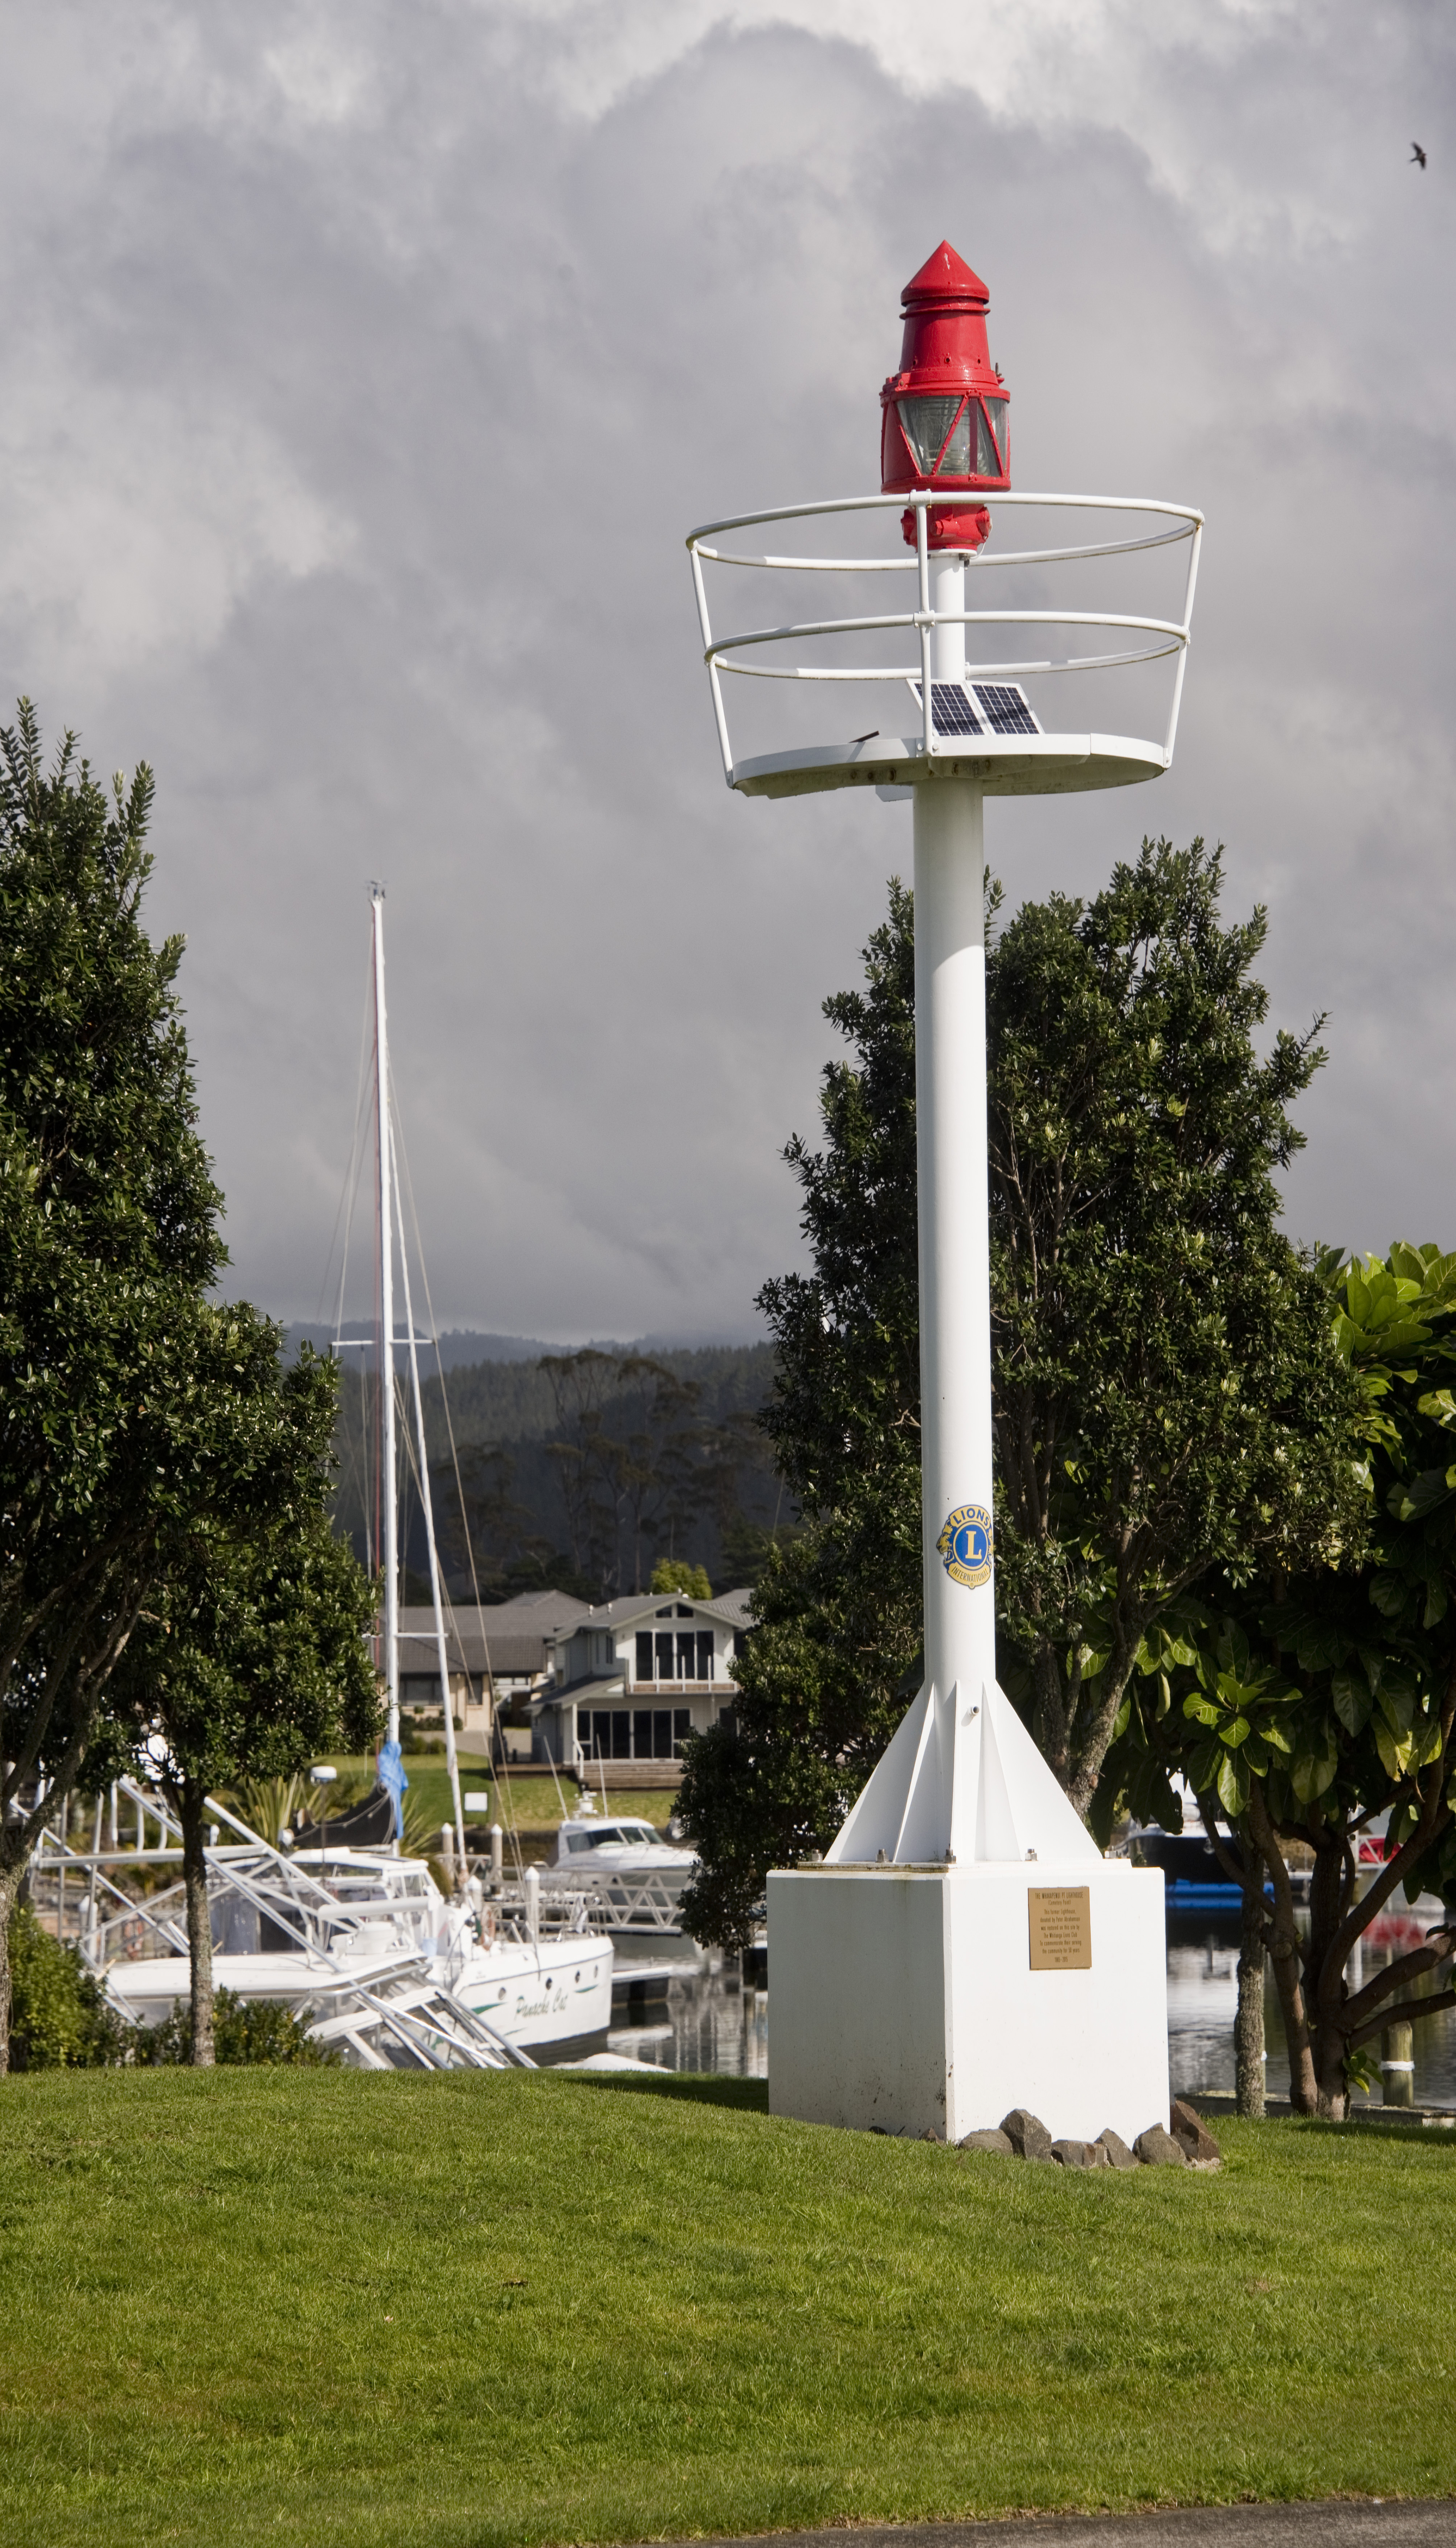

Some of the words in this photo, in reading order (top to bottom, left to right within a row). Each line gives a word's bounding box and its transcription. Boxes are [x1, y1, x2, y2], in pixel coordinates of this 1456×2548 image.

[953, 1508, 989, 1525] LIONS
[965, 1531, 982, 1559] L
[951, 1566, 989, 1582] INTERNATIONAL
